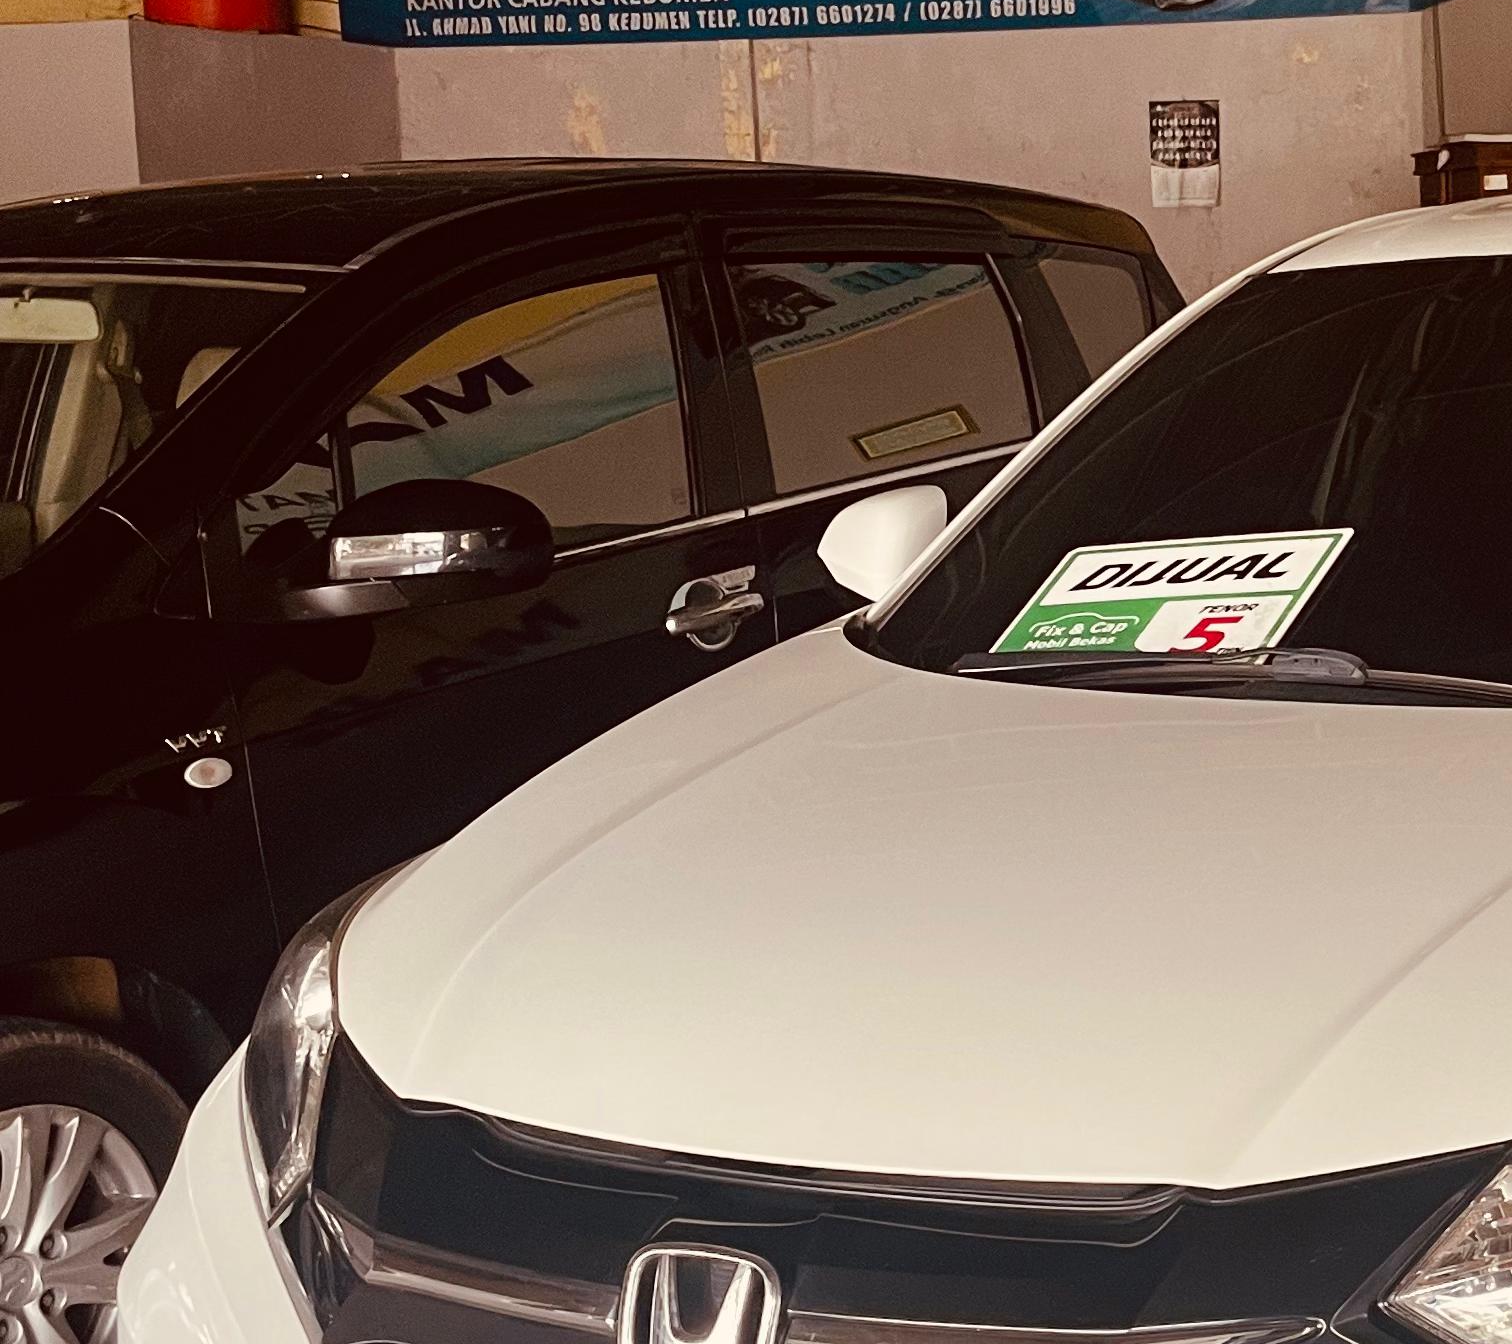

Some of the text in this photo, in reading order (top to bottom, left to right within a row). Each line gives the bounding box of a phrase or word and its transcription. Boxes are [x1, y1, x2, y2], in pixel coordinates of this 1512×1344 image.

[608, 10, 691, 31] KEBUMEN
[696, 8, 741, 30] TELP.
[1068, 551, 1296, 592] DIJUAL
[1198, 602, 1260, 615] TENOR
[1034, 623, 1066, 638] Fix
[1090, 620, 1129, 636] Cap
[1168, 615, 1244, 653] 5
[1022, 634, 1117, 651] Mobil Bekas
